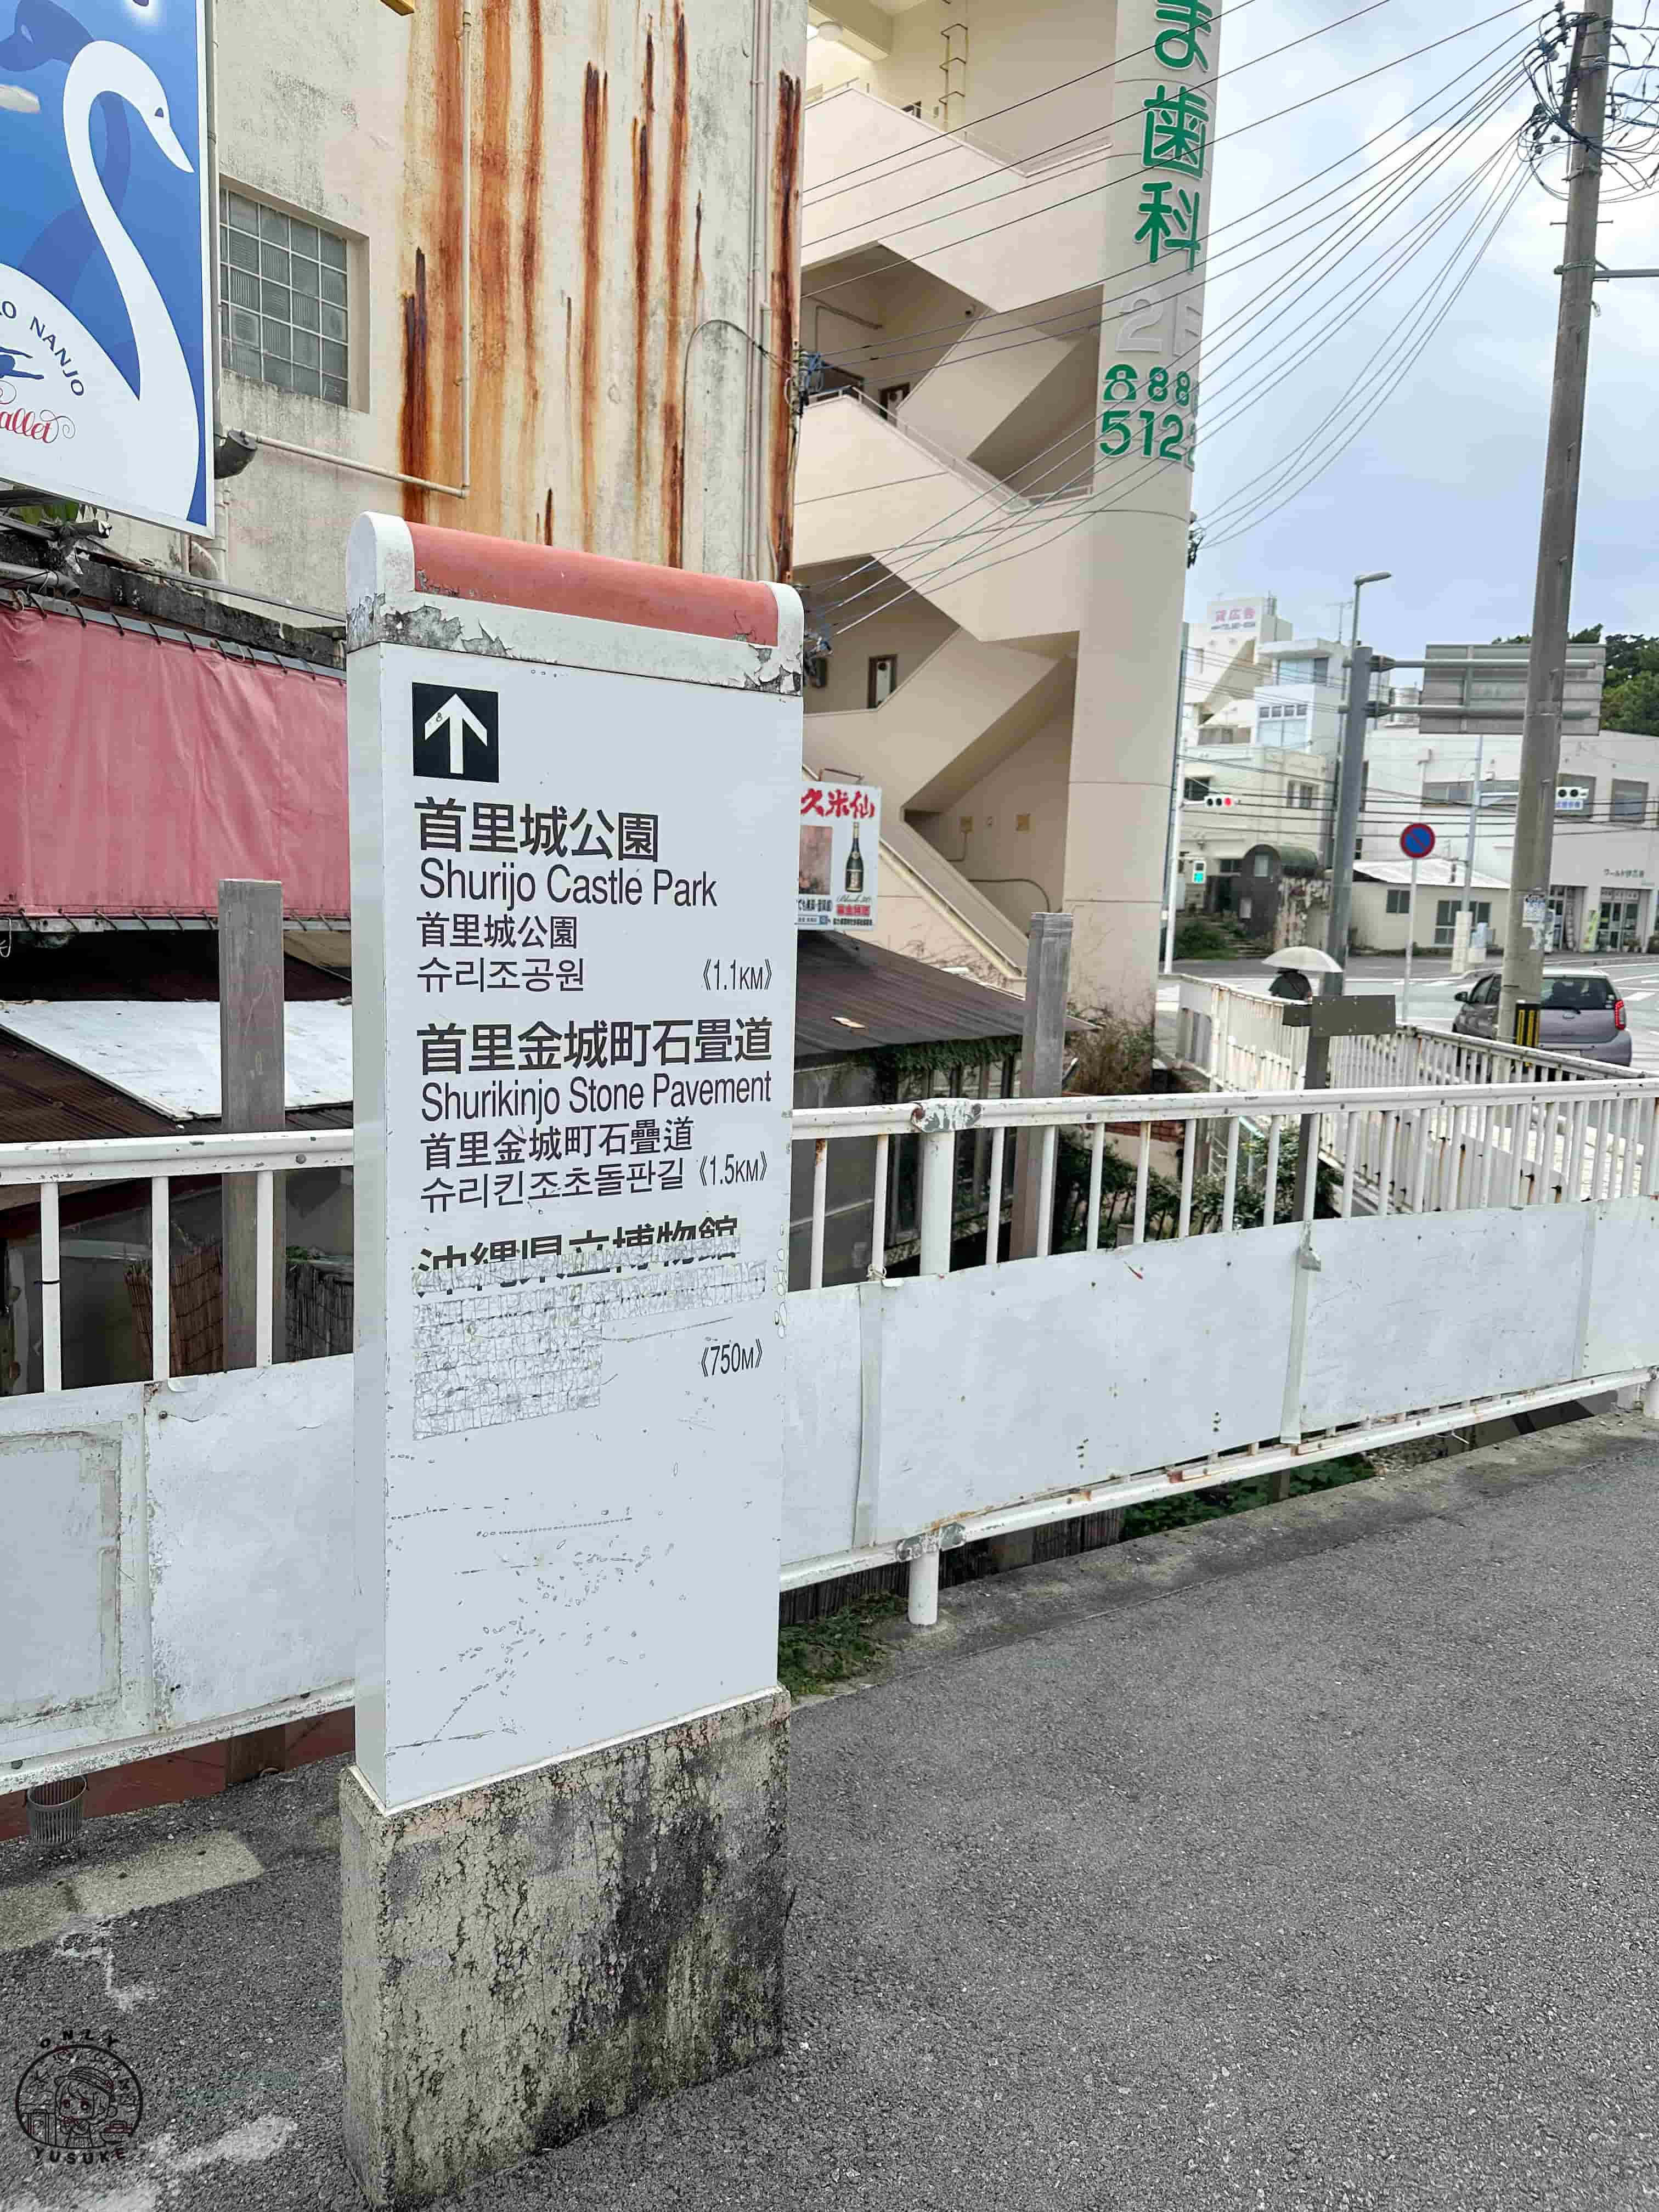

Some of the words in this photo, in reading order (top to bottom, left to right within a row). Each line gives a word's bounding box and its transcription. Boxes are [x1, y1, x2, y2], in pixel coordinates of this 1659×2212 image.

[29, 315, 84, 396] NANJO
[414, 797, 659, 862] 首里城公園
[800, 788, 876, 819] 久米仙
[420, 857, 536, 911] Shurijo
[546, 864, 643, 905] Castle
[653, 868, 718, 907] Park
[416, 911, 578, 949] 首里城公園
[417, 956, 584, 993] 슈리조공원
[416, 1016, 772, 1075] 首里金城町石畳道
[421, 1079, 560, 1125] Shurikinjo
[568, 1075, 644, 1114] Stone
[653, 1070, 772, 1108] Pavement
[421, 1156, 685, 1214] 슈리킨조초돌판길
